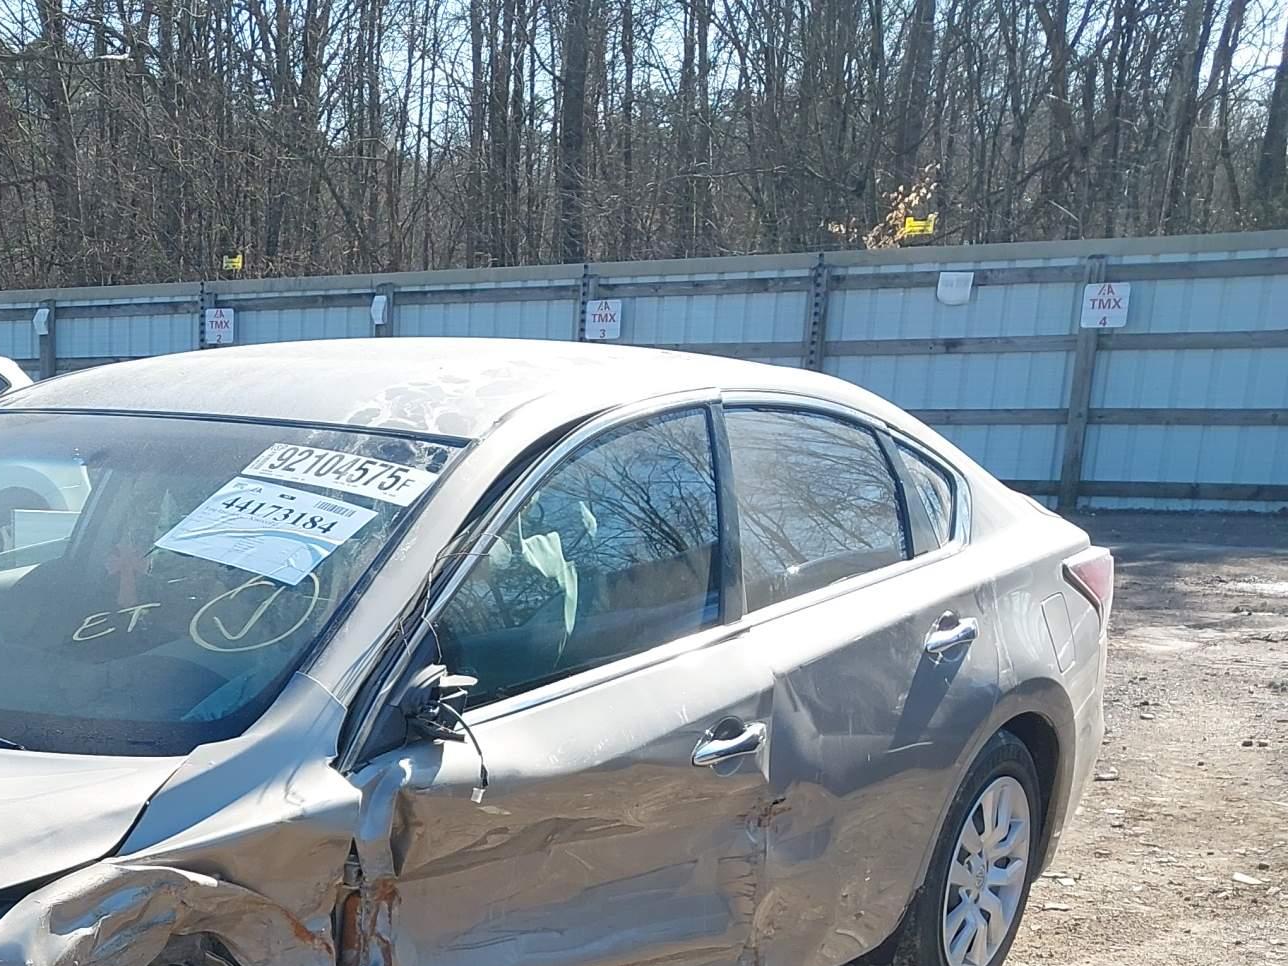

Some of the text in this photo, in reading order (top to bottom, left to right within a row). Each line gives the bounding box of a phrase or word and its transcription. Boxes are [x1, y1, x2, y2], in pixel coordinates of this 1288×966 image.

[1089, 298, 1122, 310] TMX
[592, 313, 616, 323] TMX
[1099, 316, 1108, 327] 4
[208, 320, 230, 329] TMX
[216, 334, 222, 343] 2
[599, 329, 606, 338] 3
[222, 496, 338, 534] 44173184
[73, 603, 161, 640] ET
